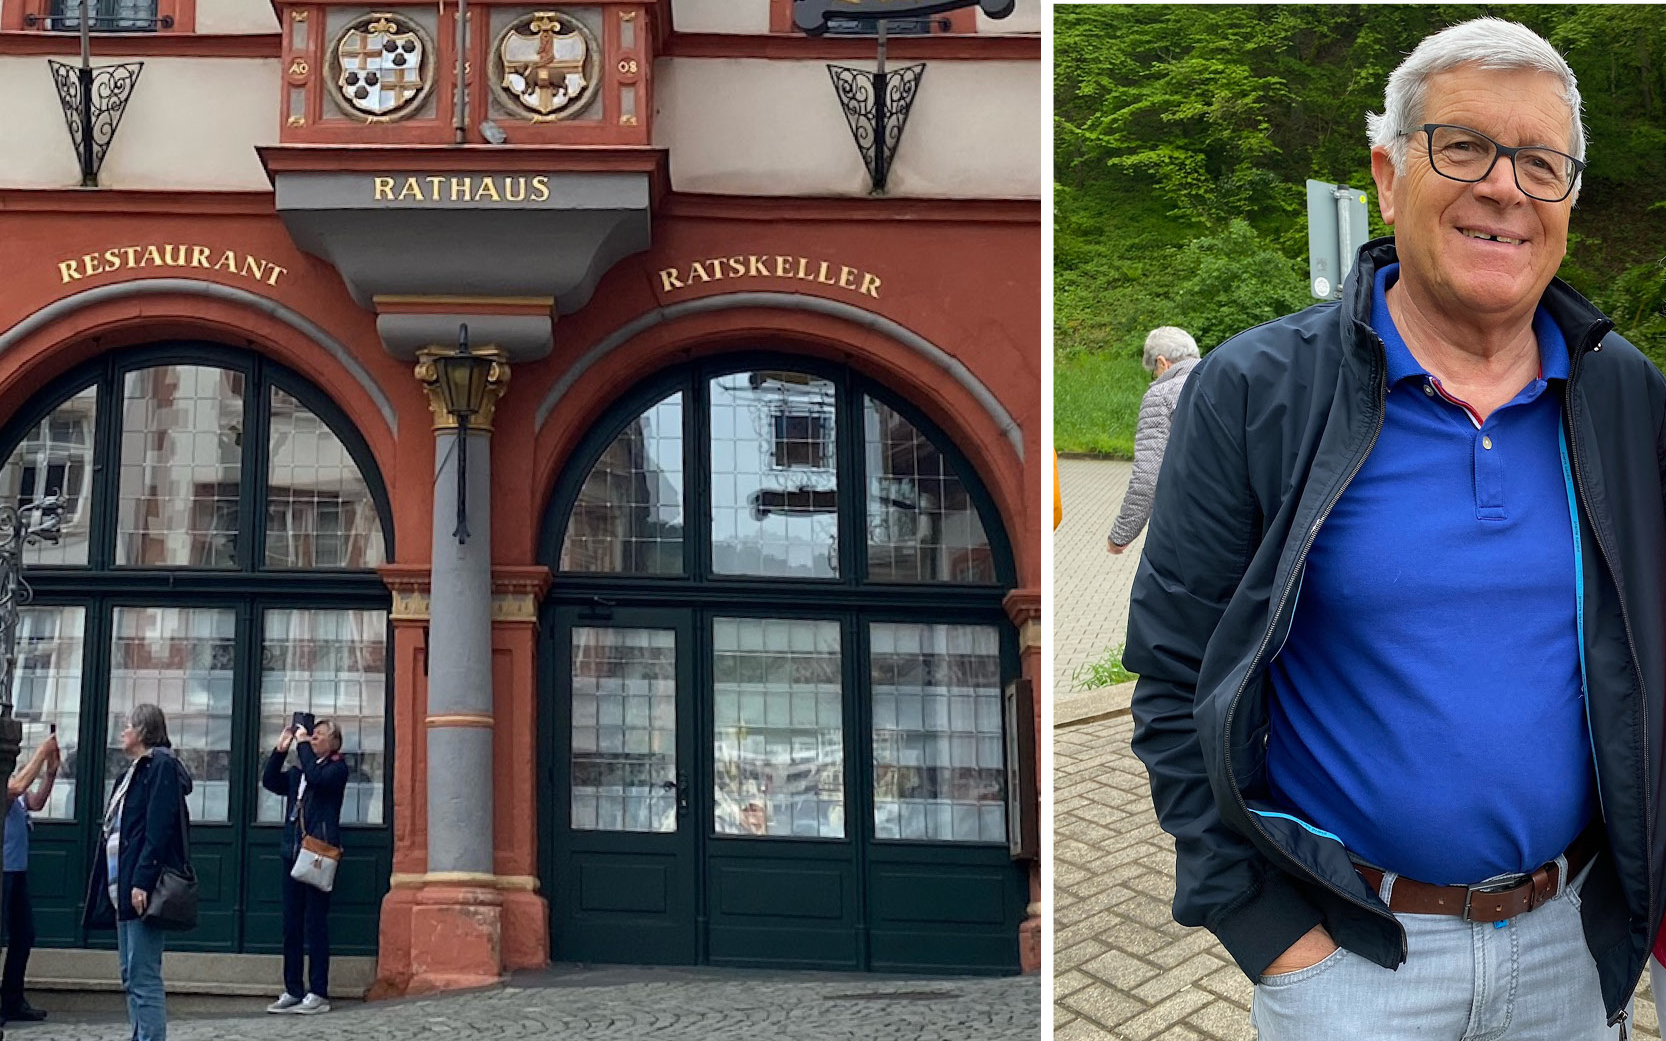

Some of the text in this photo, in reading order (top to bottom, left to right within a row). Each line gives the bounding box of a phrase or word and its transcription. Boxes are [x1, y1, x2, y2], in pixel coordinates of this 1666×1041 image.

[373, 176, 552, 202] RATHAUS
[58, 242, 288, 288] RESTAURANT
[660, 253, 882, 298] RATSKELLER
